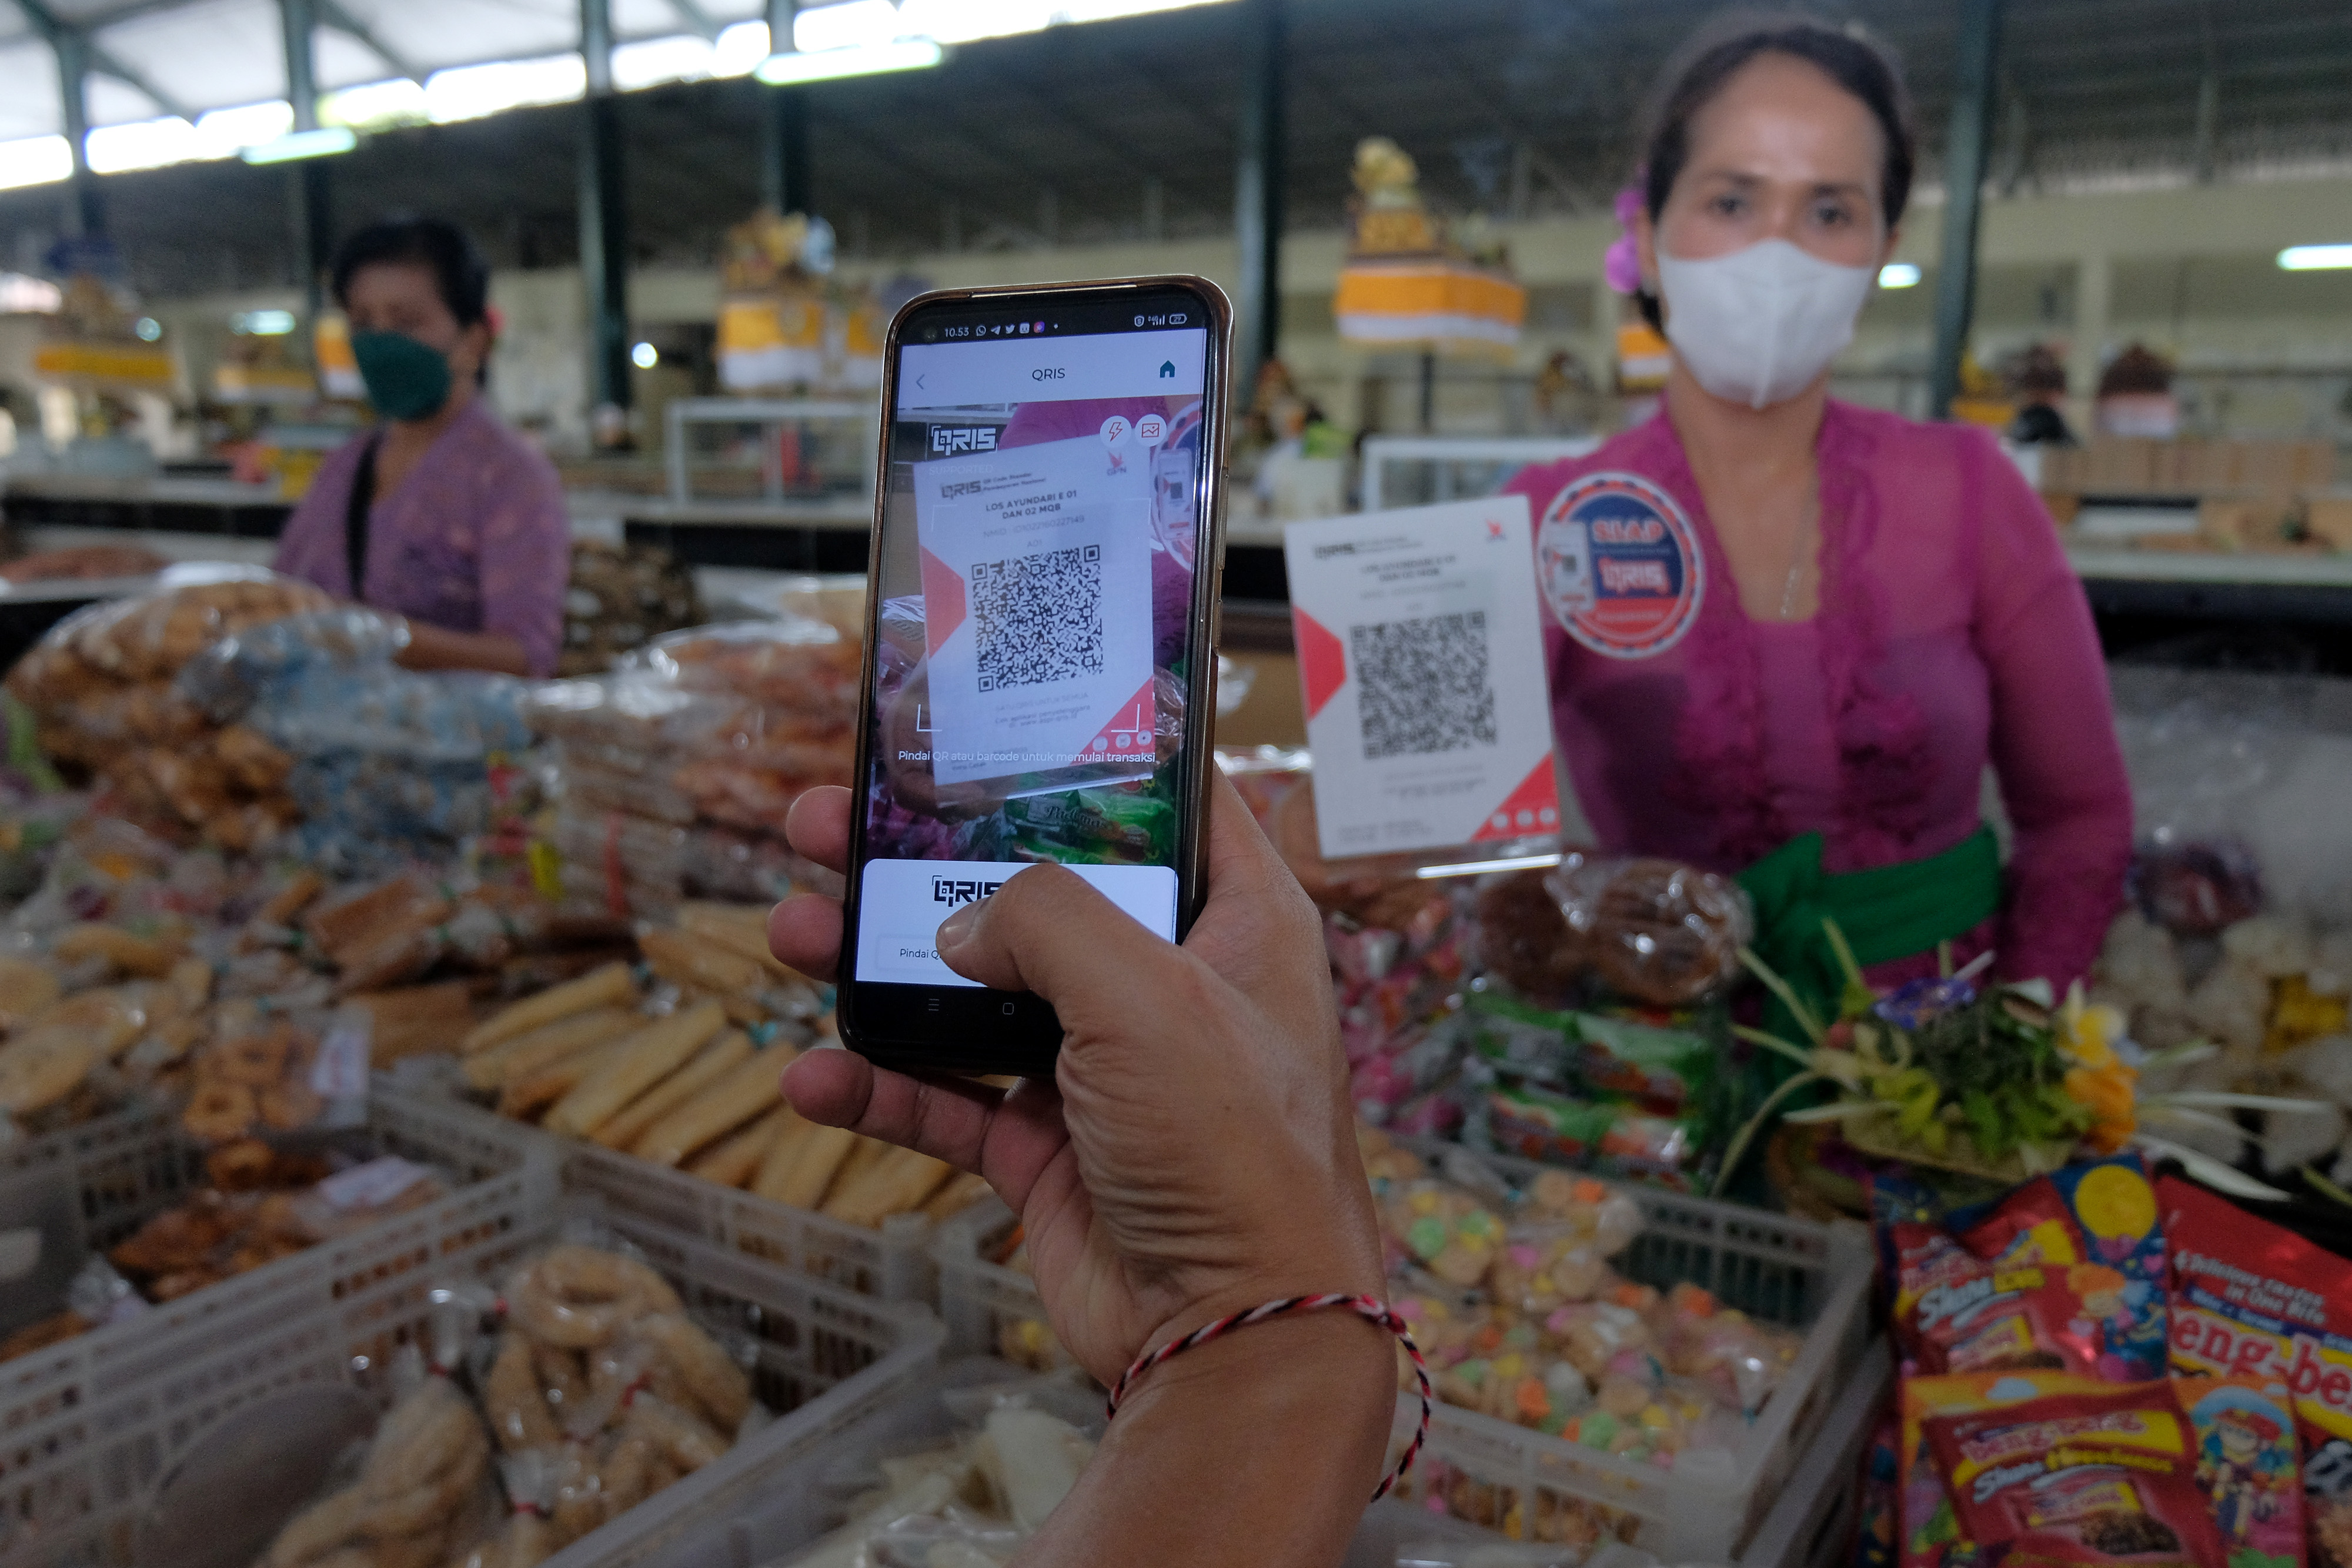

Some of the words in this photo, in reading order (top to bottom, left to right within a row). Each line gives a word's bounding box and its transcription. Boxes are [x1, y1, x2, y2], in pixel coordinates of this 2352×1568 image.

[945, 327, 969, 337] 10.53
[1032, 368, 1065, 382] QRIS
[933, 427, 996, 456] QRIS
[929, 464, 994, 475] SUPPORTED
[941, 480, 981, 499] QRIS
[986, 502, 1004, 511] LOS
[1007, 493, 1056, 508] AYUNDARI
[1058, 492, 1064, 500] E
[1066, 490, 1077, 498] 01
[1003, 510, 1022, 519] DAN
[1025, 507, 1036, 516] 02
[1039, 503, 1061, 513] MQB
[1593, 520, 1665, 543] SIAP
[898, 751, 930, 760] Pindai
[933, 751, 948, 761] QR
[951, 752, 973, 761] atau
[977, 751, 1019, 761] barcode
[1023, 752, 1053, 761] untuk
[1057, 752, 1104, 762] memulai
[1107, 753, 1155, 763] transaksi
[900, 948, 928, 958] Pindai
[931, 950, 941, 959] Q
[2247, 1286, 2283, 1310] One
[2174, 1315, 2352, 1406] eng-be
